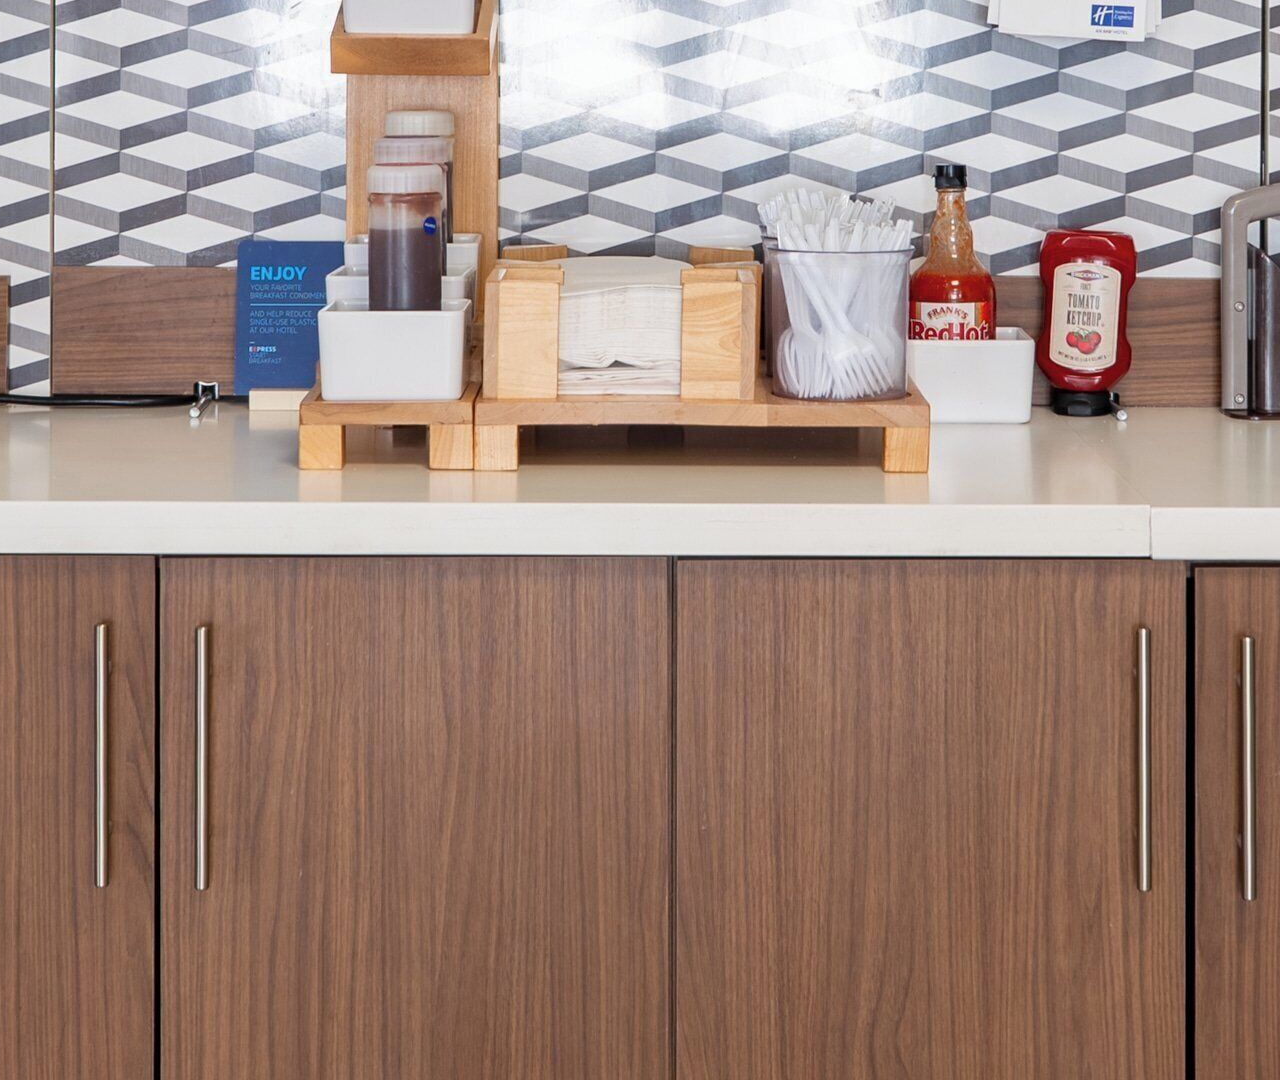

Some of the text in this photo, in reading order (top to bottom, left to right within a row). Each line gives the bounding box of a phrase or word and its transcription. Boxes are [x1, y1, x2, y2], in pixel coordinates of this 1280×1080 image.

[250, 266, 307, 281] ENJOY
[1067, 293, 1101, 310] TOMATO
[927, 306, 969, 320] FRANK'S
[1066, 310, 1102, 327] KETCHUP
[290, 318, 317, 326] PLASTIC
[910, 319, 989, 340] RedHot
